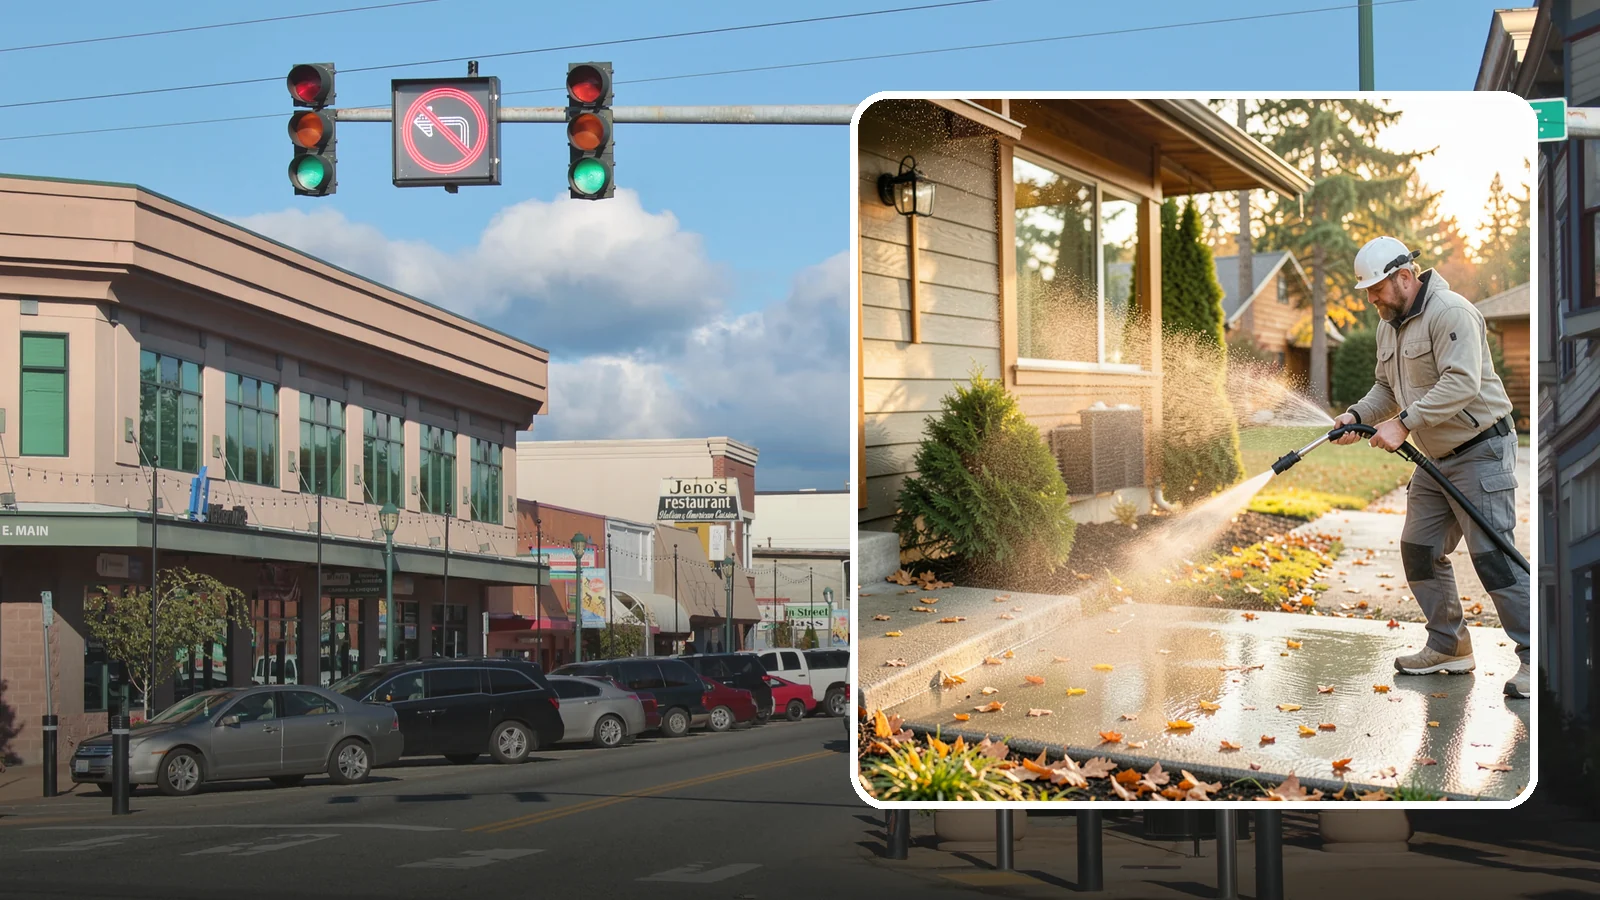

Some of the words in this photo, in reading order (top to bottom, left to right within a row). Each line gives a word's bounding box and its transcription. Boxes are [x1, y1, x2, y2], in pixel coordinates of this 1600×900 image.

[669, 480, 727, 494] Jeno's
[665, 496, 731, 508] restaurant
[658, 510, 681, 520] Italian
[686, 510, 715, 519] American
[715, 509, 737, 519] Cuisine
[2, 525, 13, 536] E.
[15, 525, 49, 536] MAIN
[797, 607, 828, 617] Street
